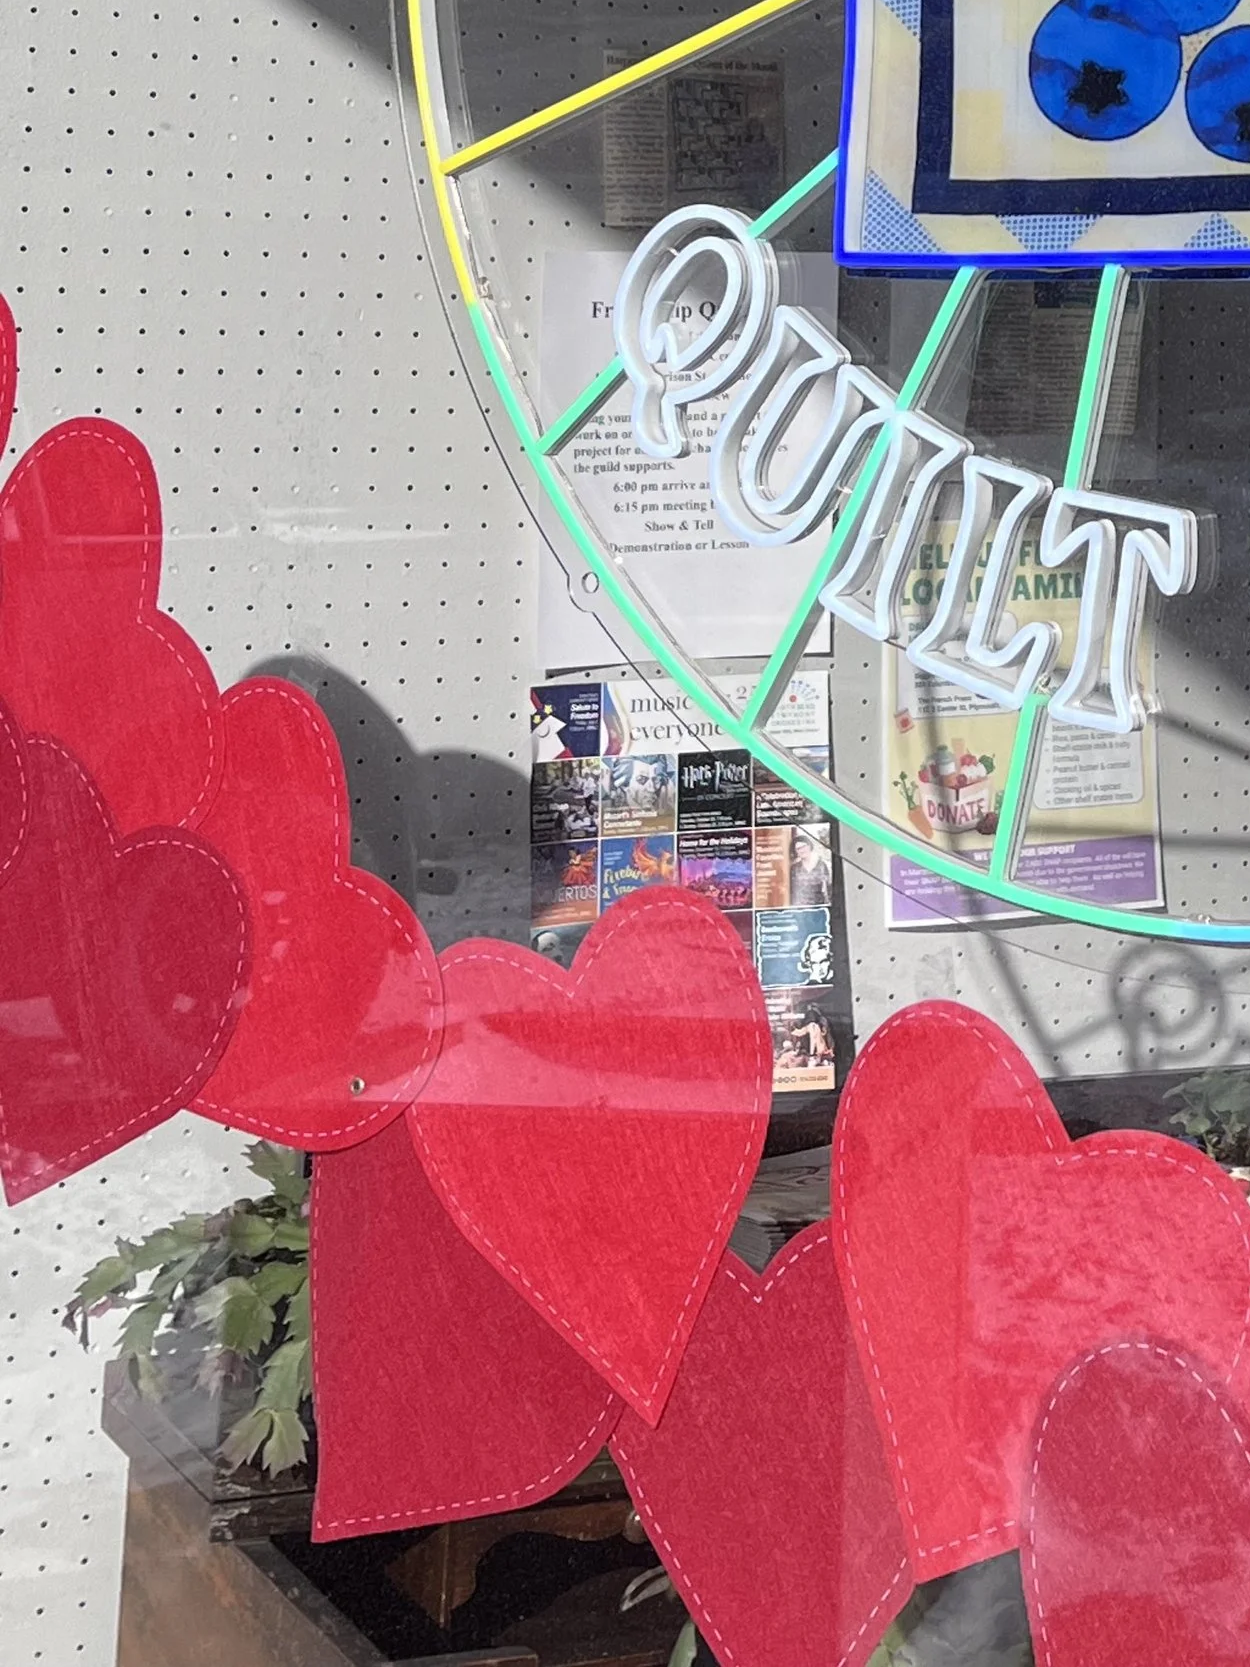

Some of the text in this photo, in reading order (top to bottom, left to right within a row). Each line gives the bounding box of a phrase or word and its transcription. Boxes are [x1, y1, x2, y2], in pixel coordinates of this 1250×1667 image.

[573, 447, 612, 460] project
[615, 445, 631, 455] for
[573, 463, 590, 473] the
[592, 461, 621, 475] guild
[613, 202, 1200, 734] QUILT
[613, 482, 638, 493] 6:00
[640, 483, 659, 494] pm
[613, 499, 708, 514] 6:15 pm meeting
[644, 519, 714, 532] Show & Tell
[630, 690, 693, 713] music
[629, 720, 725, 745] everyone
[927, 798, 985, 825] DONATE
